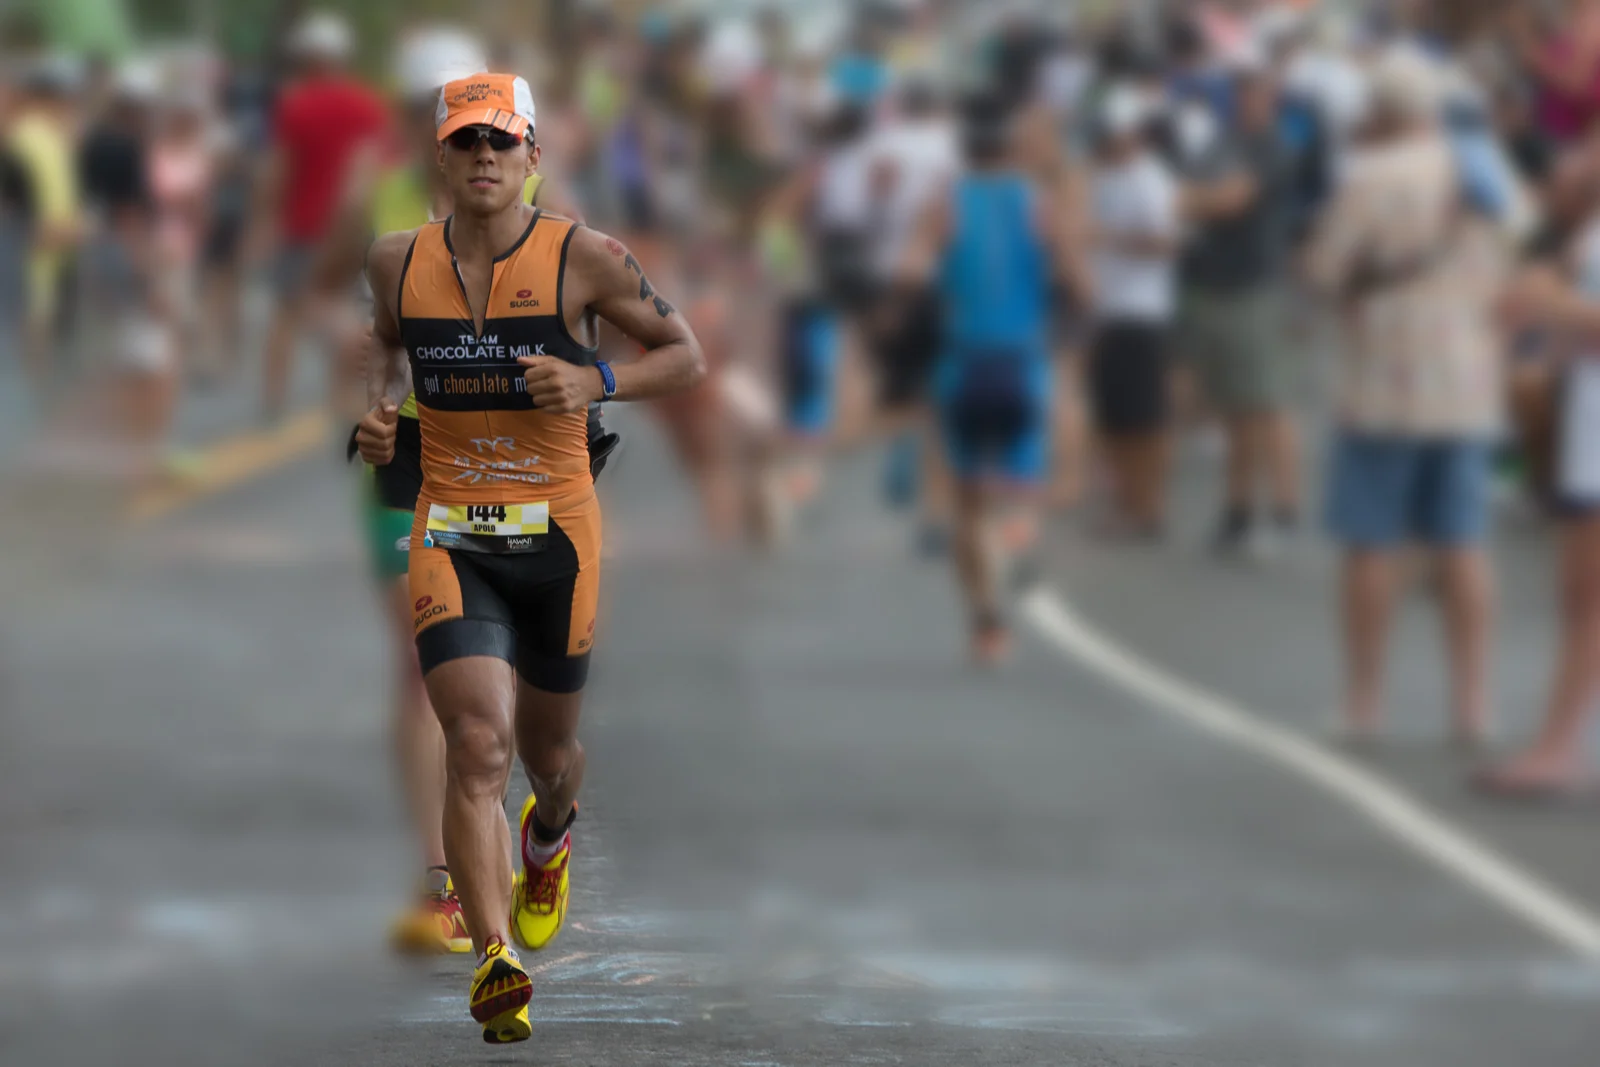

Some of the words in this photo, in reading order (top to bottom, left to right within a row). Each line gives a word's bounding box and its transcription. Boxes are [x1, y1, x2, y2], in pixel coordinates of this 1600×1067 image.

[454, 89, 502, 102] CHOCOLATE
[467, 95, 488, 103] MILK
[459, 335, 498, 344] TEAM
[416, 346, 506, 360] CHOCOLATE
[509, 343, 546, 358] MILK
[424, 374, 440, 395] got
[444, 373, 509, 394] chocolate
[469, 436, 517, 453] TYR
[466, 505, 507, 522] 144
[473, 524, 496, 532] APOLO
